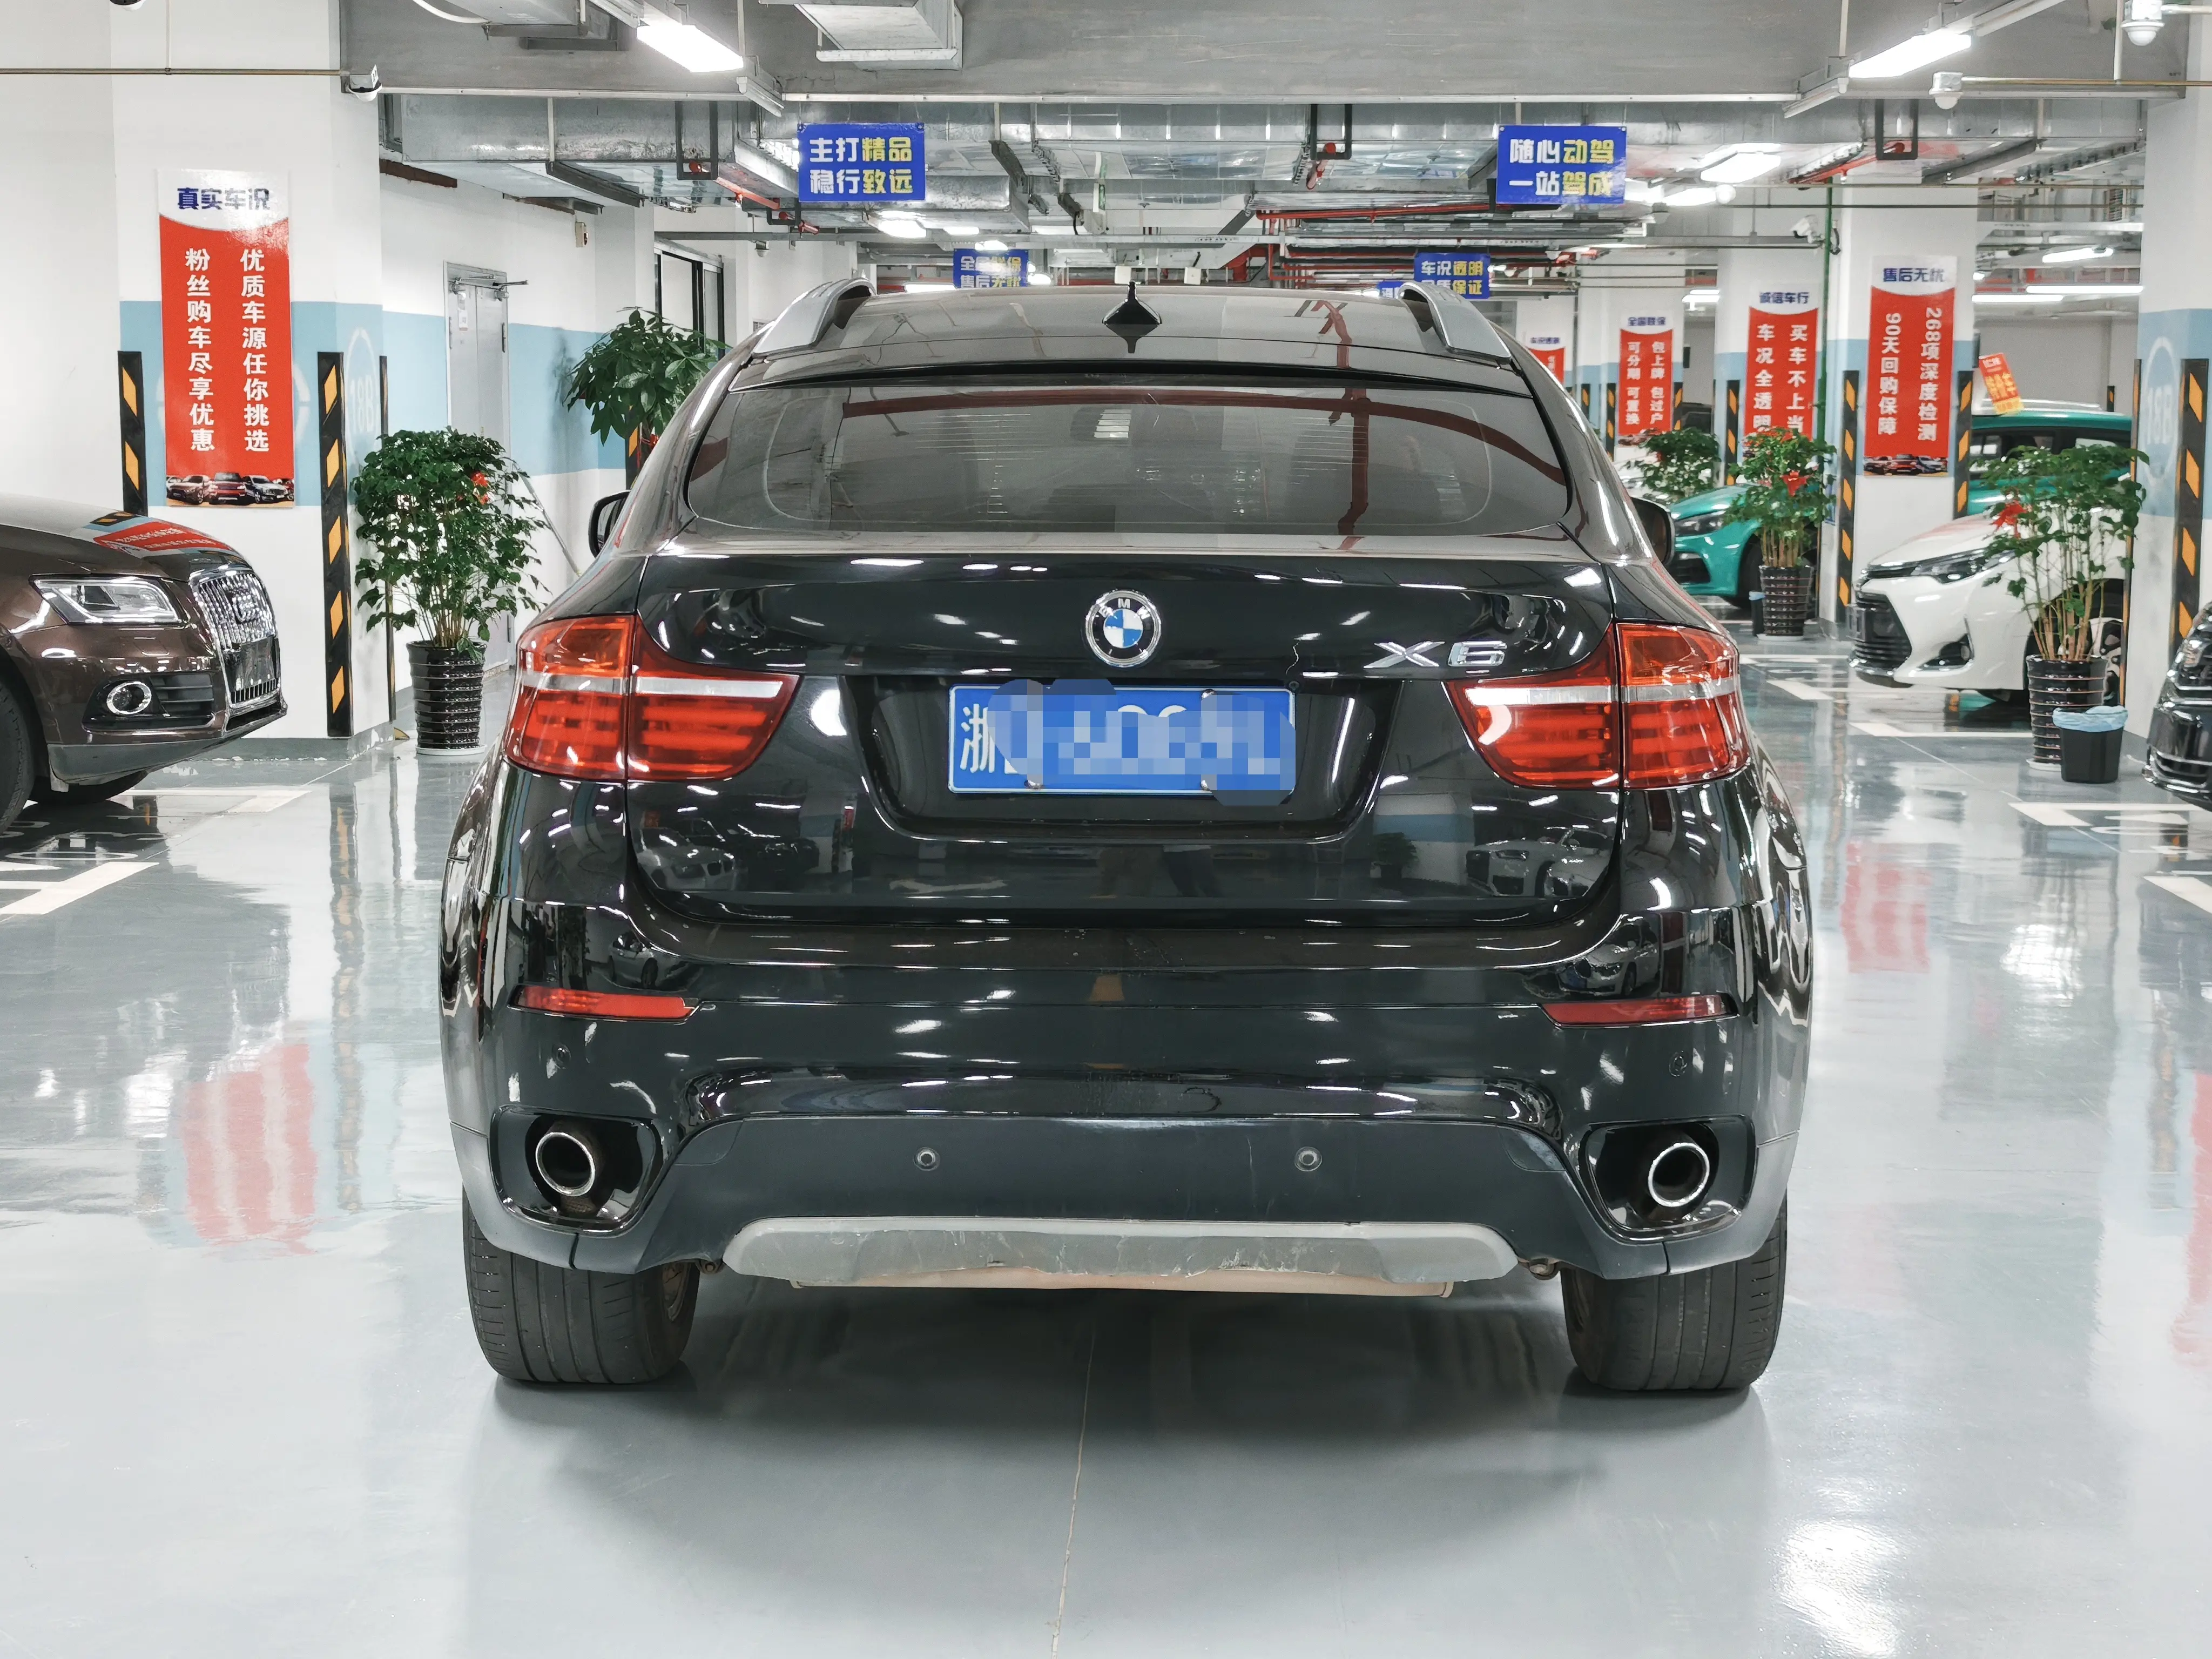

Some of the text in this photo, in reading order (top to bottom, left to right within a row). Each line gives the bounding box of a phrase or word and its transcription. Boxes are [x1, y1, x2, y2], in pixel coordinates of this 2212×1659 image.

[810, 137, 912, 162] 主打精品
[1509, 139, 1615, 164] 随心动驾
[810, 168, 913, 194] 稳行致远
[1509, 171, 1613, 196] 一站驾成
[177, 187, 270, 210] 真实车况
[1421, 260, 1483, 276] 车况透明
[1883, 267, 1945, 282] 售后无忧
[1759, 292, 1810, 305] 诚信车行
[185, 248, 215, 451] 粉丝购车尽享优惠
[240, 249, 270, 452] 优质车源任你挑选
[1627, 341, 1641, 380] 可分期
[1649, 341, 1665, 424] 包上牌 包过户
[1752, 324, 1775, 430] 车况全透明
[1786, 325, 1809, 433] 买车不上当
[1878, 313, 1901, 435] 90天回购保障
[1917, 307, 1942, 441] 268项深度检测
[1098, 598, 1151, 620] BMW
[1364, 640, 1507, 668] X6
